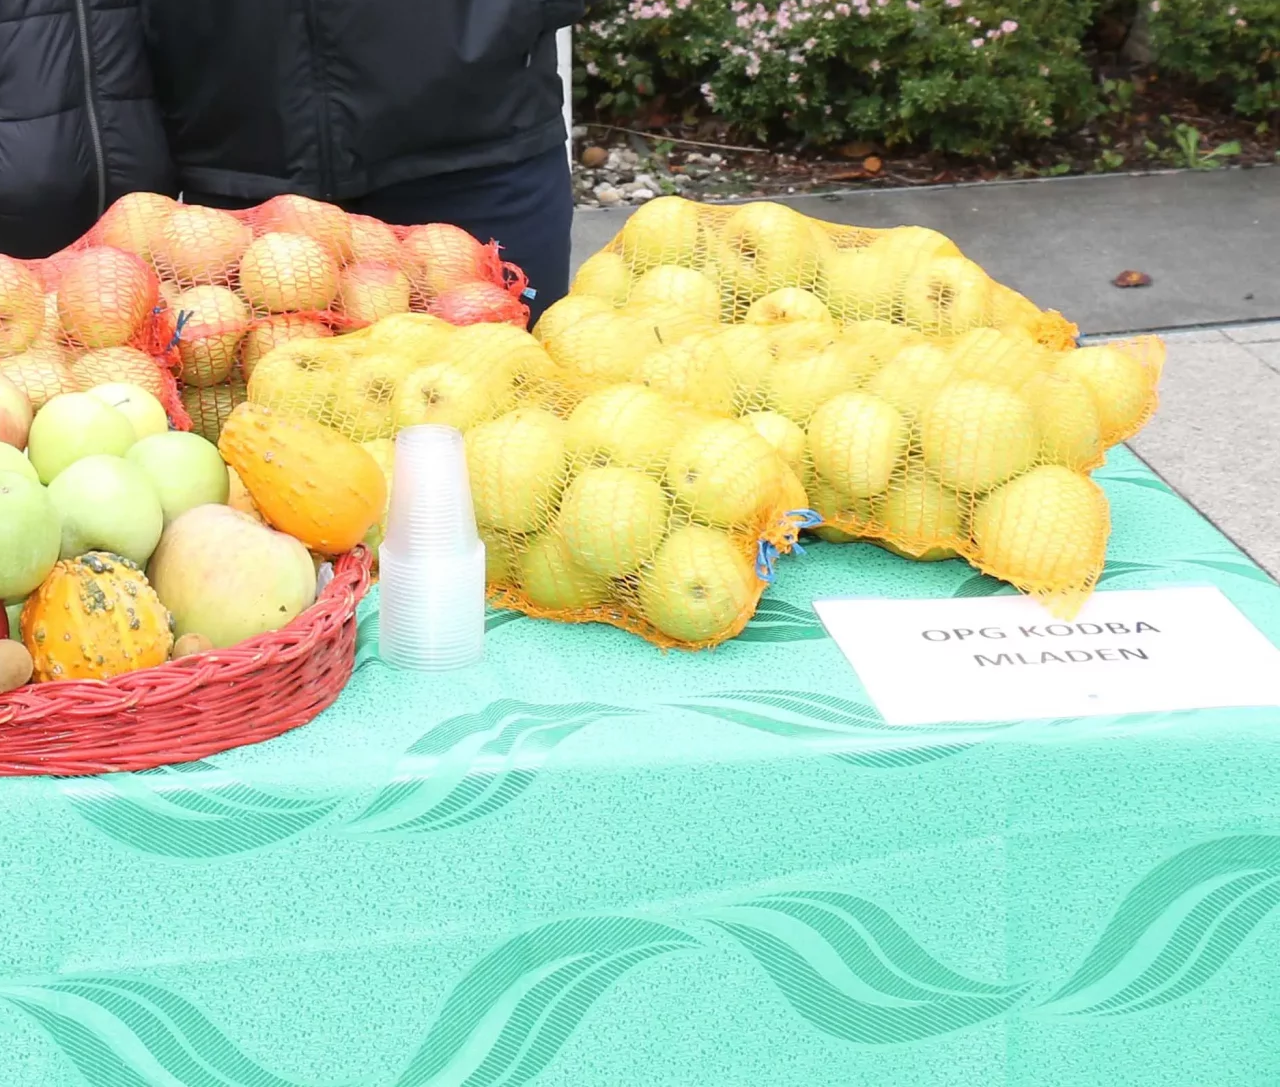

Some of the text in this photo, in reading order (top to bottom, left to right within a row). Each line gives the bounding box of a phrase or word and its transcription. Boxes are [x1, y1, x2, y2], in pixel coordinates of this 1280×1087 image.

[921, 621, 1161, 642] OPG KODBA
[973, 647, 1149, 667] MLADEN
